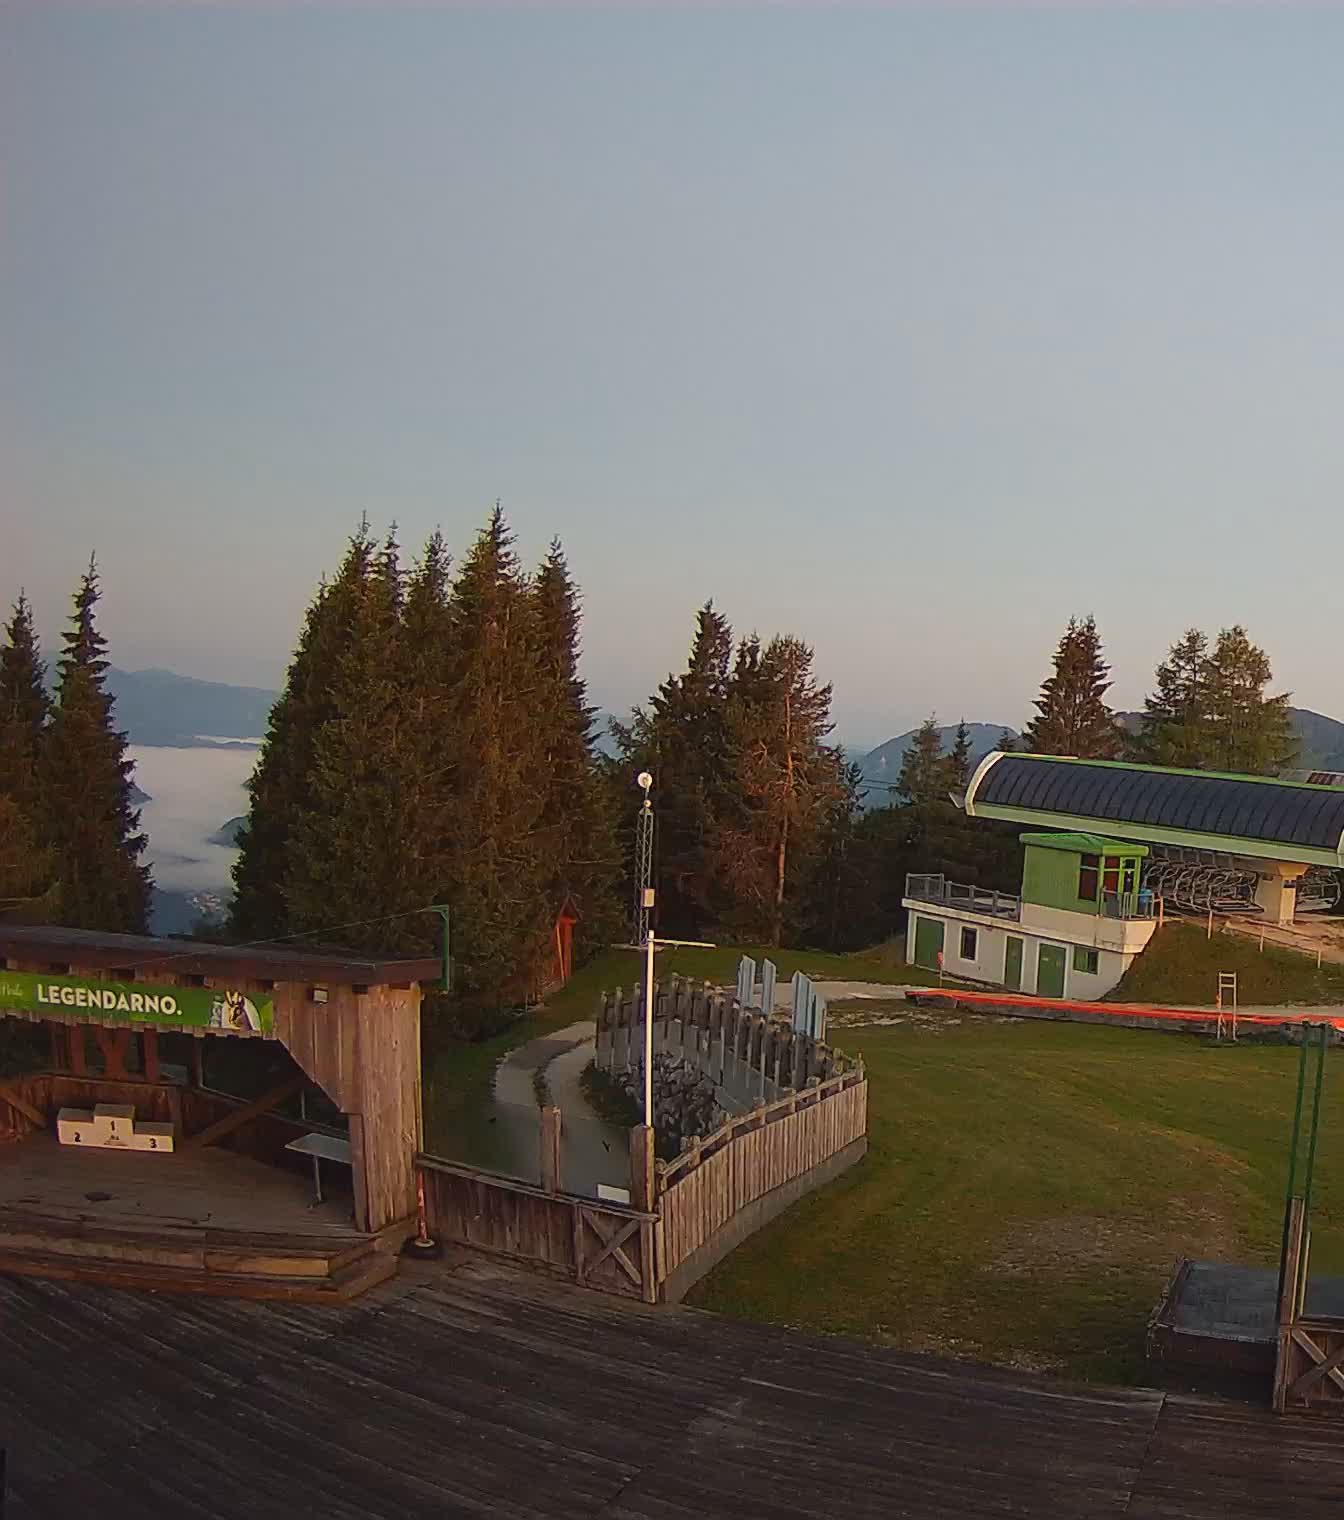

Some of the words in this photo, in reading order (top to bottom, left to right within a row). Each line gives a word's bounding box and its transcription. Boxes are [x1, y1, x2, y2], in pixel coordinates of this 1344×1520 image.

[37, 983, 183, 1016] LEGENDARNO.
[110, 1120, 116, 1131] 1
[74, 1132, 81, 1143] 2
[149, 1138, 157, 1149] 3
